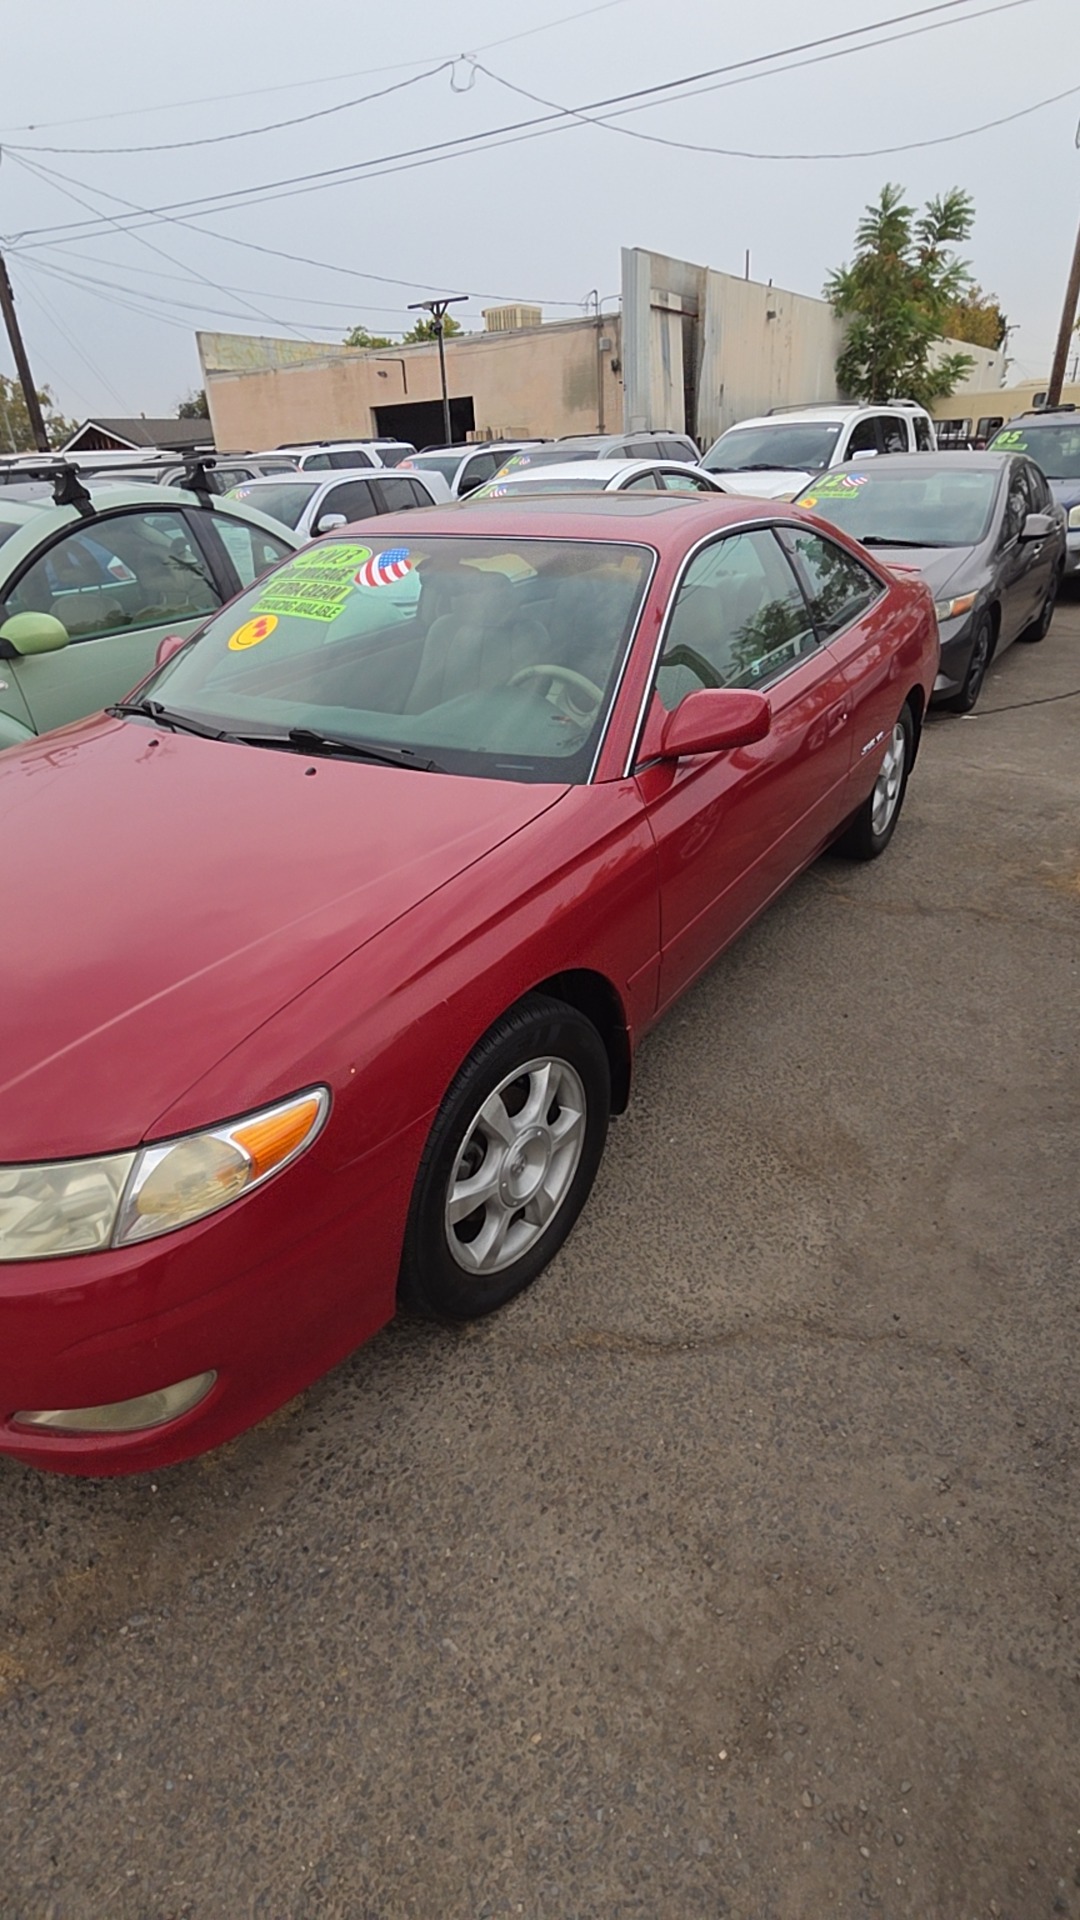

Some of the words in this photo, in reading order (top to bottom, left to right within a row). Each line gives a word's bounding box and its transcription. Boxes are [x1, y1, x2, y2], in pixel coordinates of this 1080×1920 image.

[997, 430, 1024, 445] 05
[815, 473, 848, 488] 12
[300, 583, 349, 602] CLEAN
